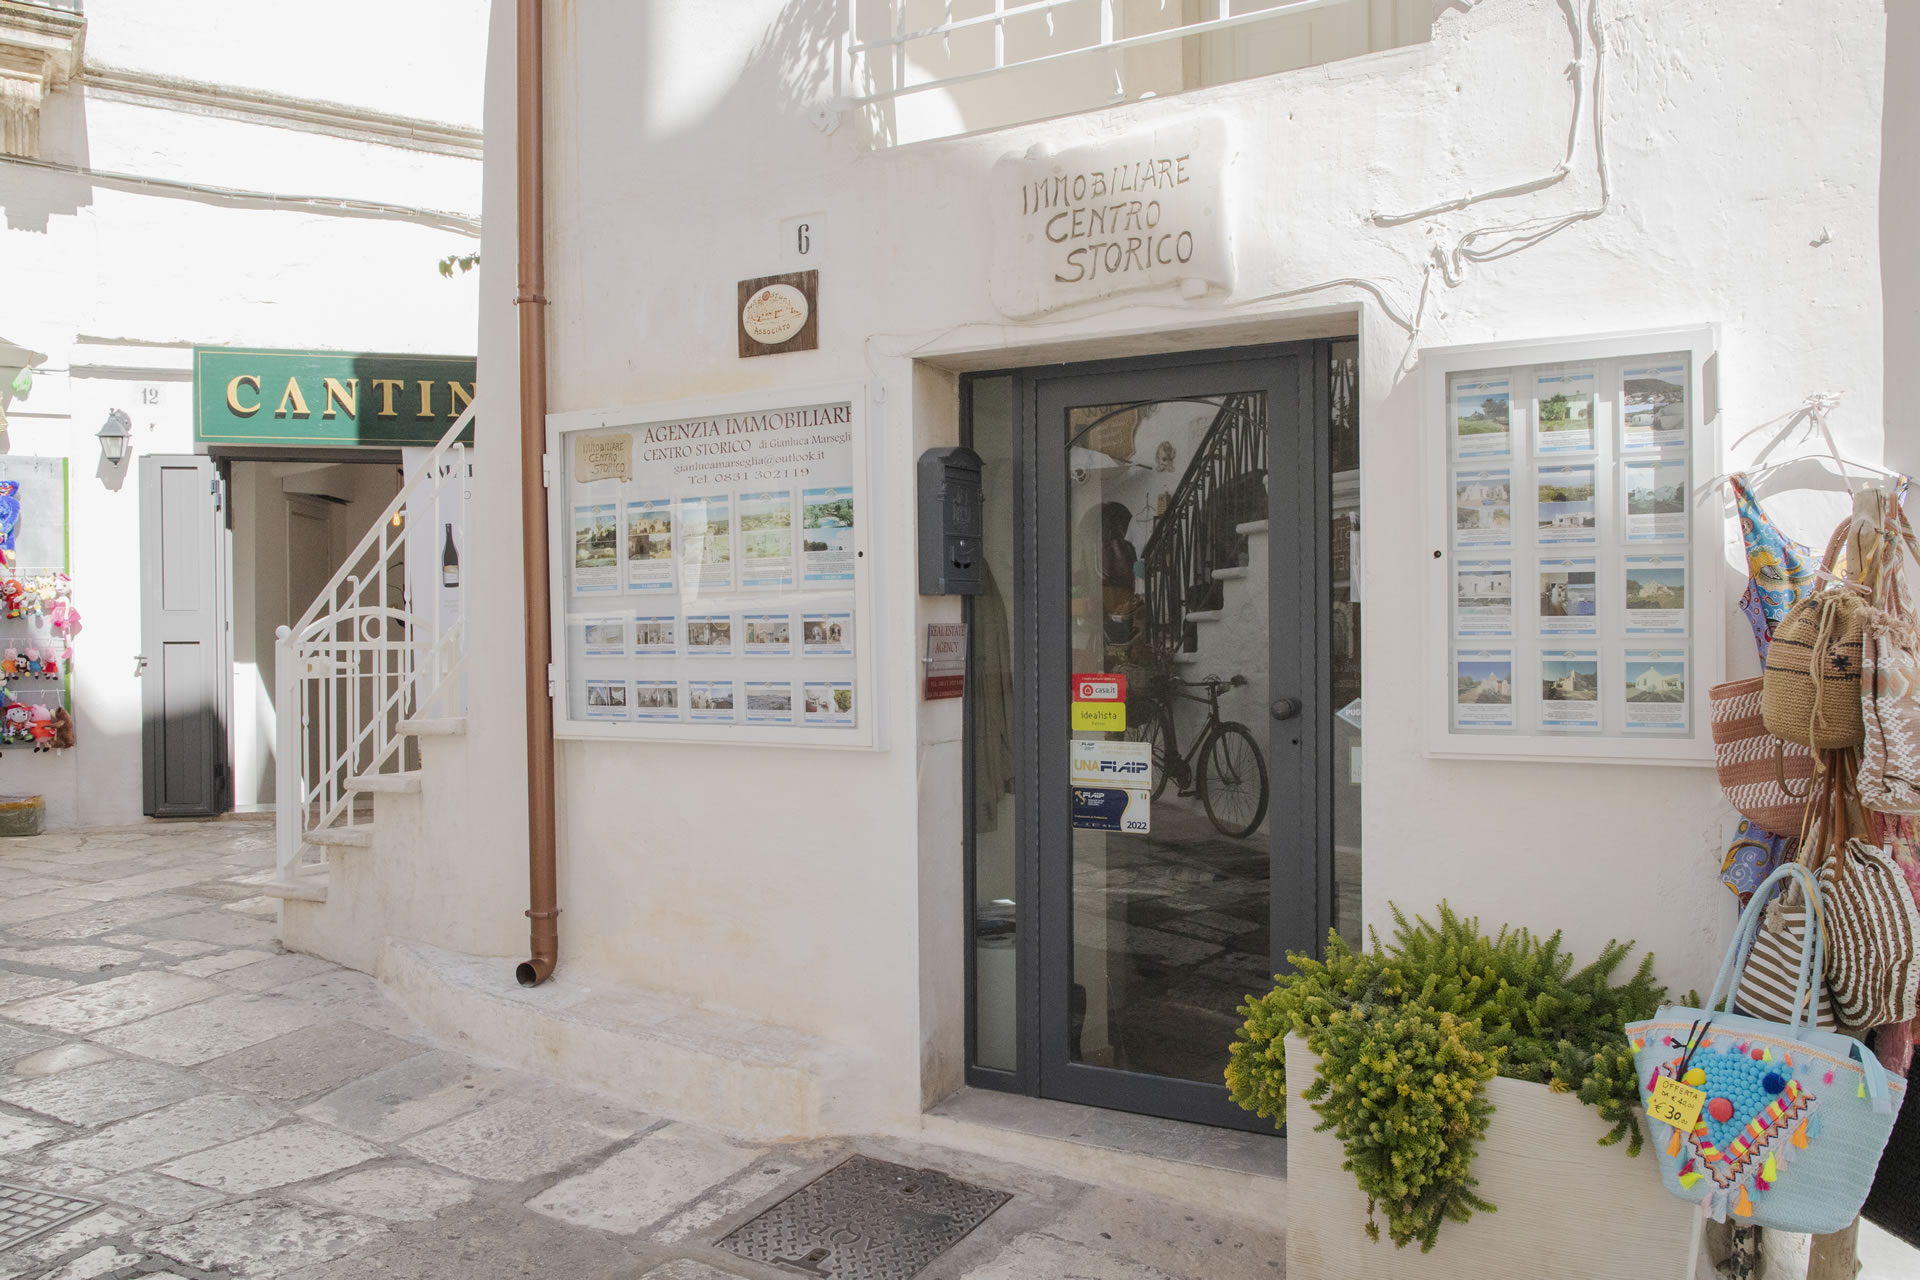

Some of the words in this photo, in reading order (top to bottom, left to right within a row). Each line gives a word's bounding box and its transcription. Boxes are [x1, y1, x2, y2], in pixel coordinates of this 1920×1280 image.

[1022, 154, 1190, 215] IMMOBILIARE
[1045, 200, 1161, 243] CENTRO
[797, 223, 810, 255] 6
[1055, 230, 1194, 283] STORICO
[141, 387, 159, 405] 12
[644, 420, 720, 444] AGENZIA
[643, 445, 692, 462] CENTRO
[695, 439, 752, 457] STORICO
[758, 439, 768, 449] di
[769, 436, 809, 449] Gianluca
[714, 471, 748, 483] 0831
[935, 641, 960, 654] AGENCY
[1081, 710, 1118, 720] idealista
[1126, 821, 1148, 830] 2022
[1662, 1080, 1698, 1099] OFFERTA
